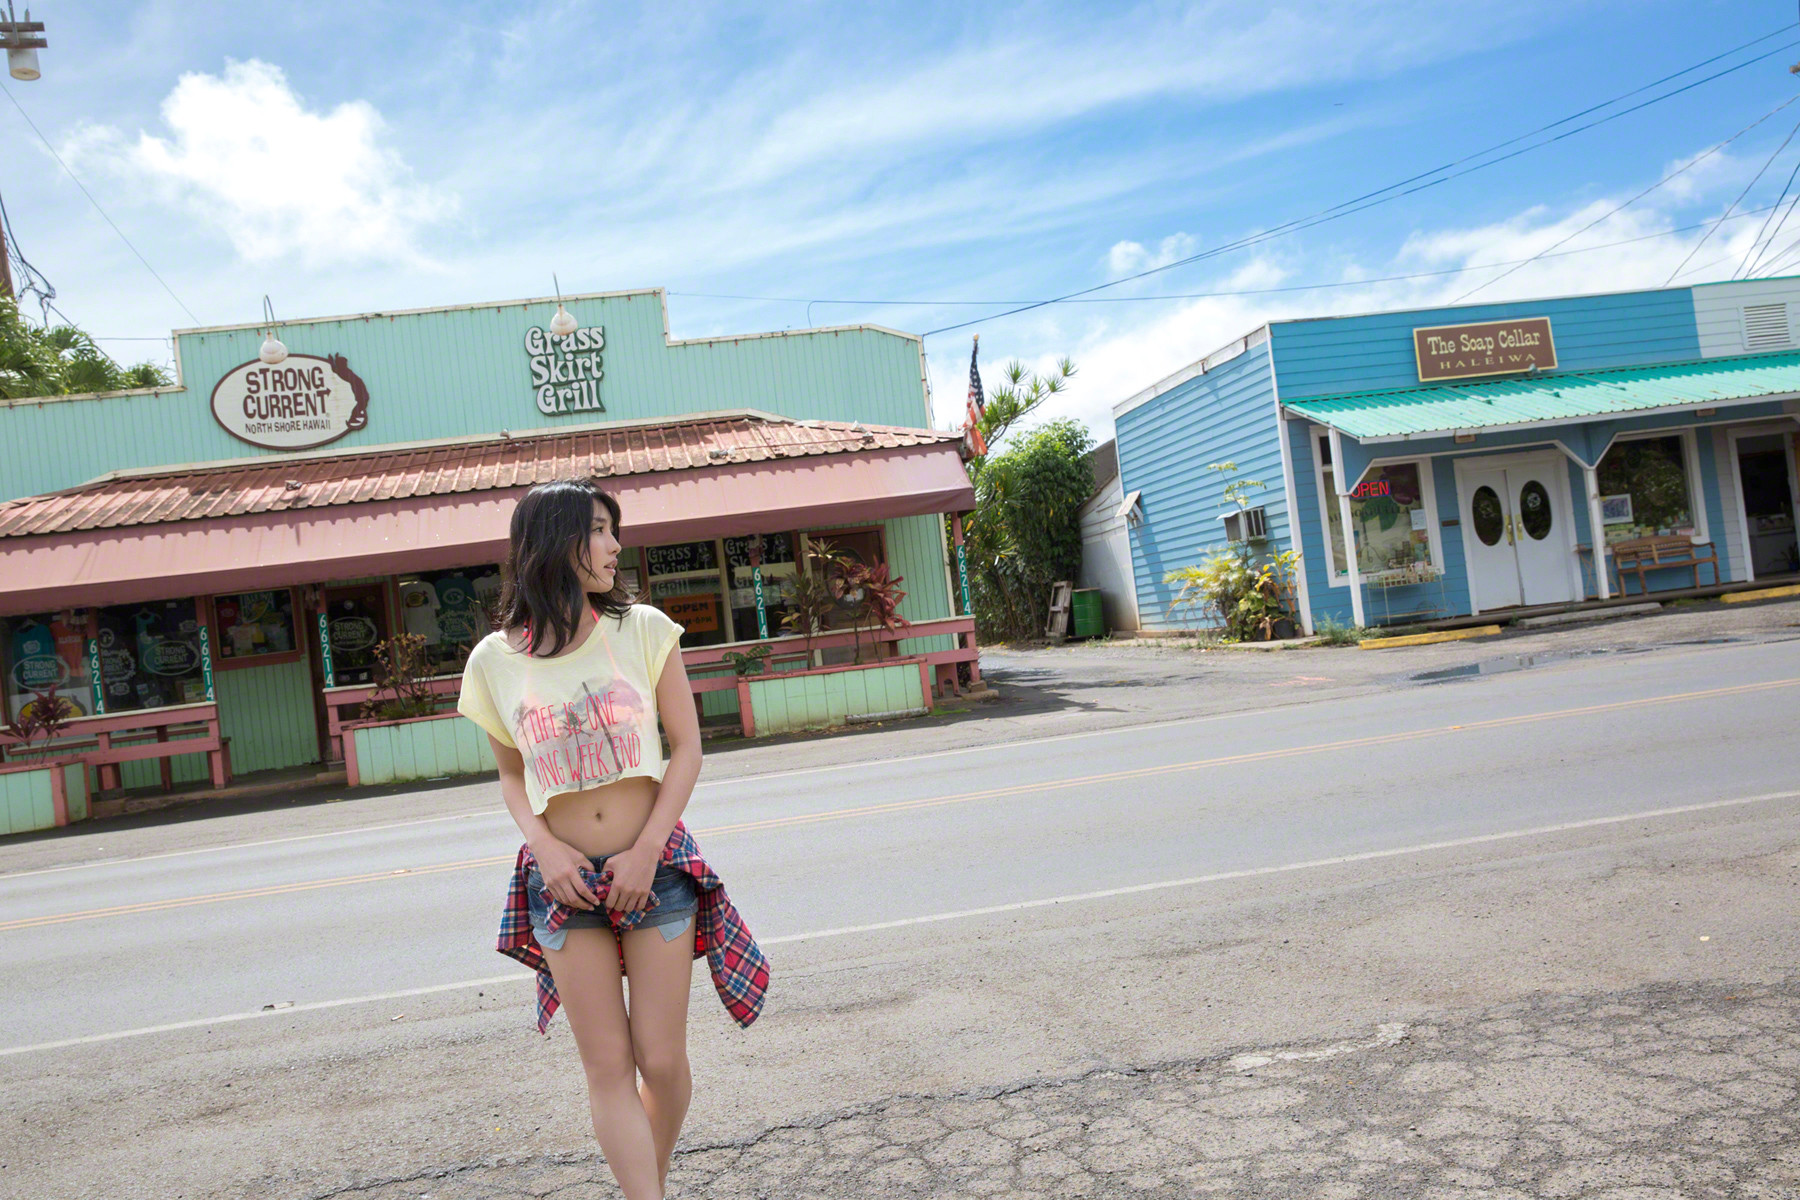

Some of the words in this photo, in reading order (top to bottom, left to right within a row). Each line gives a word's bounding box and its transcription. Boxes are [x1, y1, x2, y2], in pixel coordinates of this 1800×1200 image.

[525, 326, 605, 356] Grass
[1427, 336, 1456, 355] The
[1460, 333, 1494, 355] Soap
[1498, 328, 1541, 348] Cellar
[530, 351, 603, 386] Skirt
[1439, 353, 1536, 370] HALEIWA
[245, 366, 325, 394] STRONG
[243, 389, 329, 420] CURRENT
[536, 379, 602, 414] Grill
[245, 421, 273, 435] NORTH
[274, 420, 301, 433] SHORE
[302, 419, 331, 431] HAWAII
[1351, 480, 1390, 499] OPEN
[647, 546, 691, 564] Grass
[957, 546, 972, 615] 66214
[670, 602, 709, 614] OPEN
[753, 567, 768, 638] 66214
[23, 659, 56, 670] STRONG
[199, 626, 214, 700] 66214
[319, 613, 334, 687] 66214
[22, 669, 58, 681] CURRENT
[89, 639, 105, 714] 66214
[528, 704, 560, 744] LIFE
[562, 701, 582, 736] IS
[585, 691, 619, 731] ONE
[565, 739, 609, 782] WEEK
[611, 732, 641, 772] END
